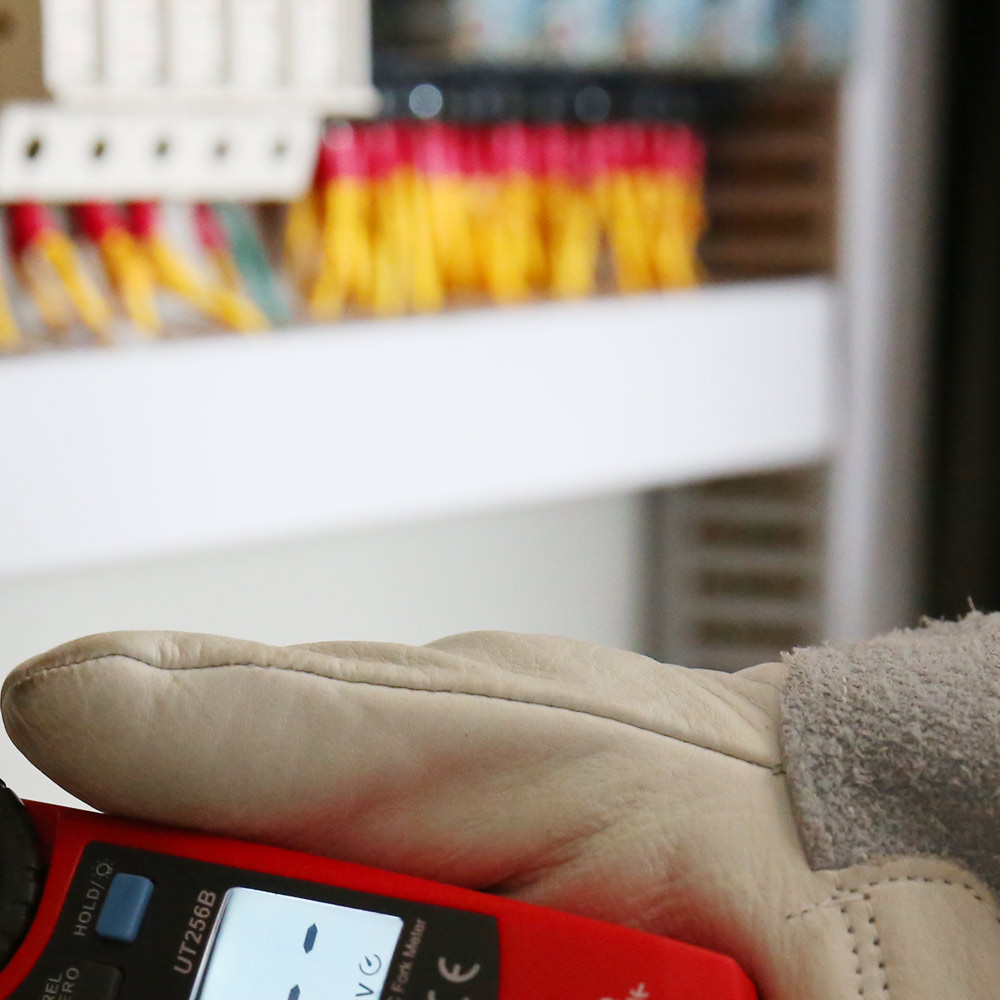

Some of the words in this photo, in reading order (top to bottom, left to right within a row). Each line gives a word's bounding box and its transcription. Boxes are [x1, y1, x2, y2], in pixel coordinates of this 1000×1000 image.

[173, 889, 217, 975] UT256B
[390, 960, 414, 993] Fork
[402, 917, 427, 958] Meter
